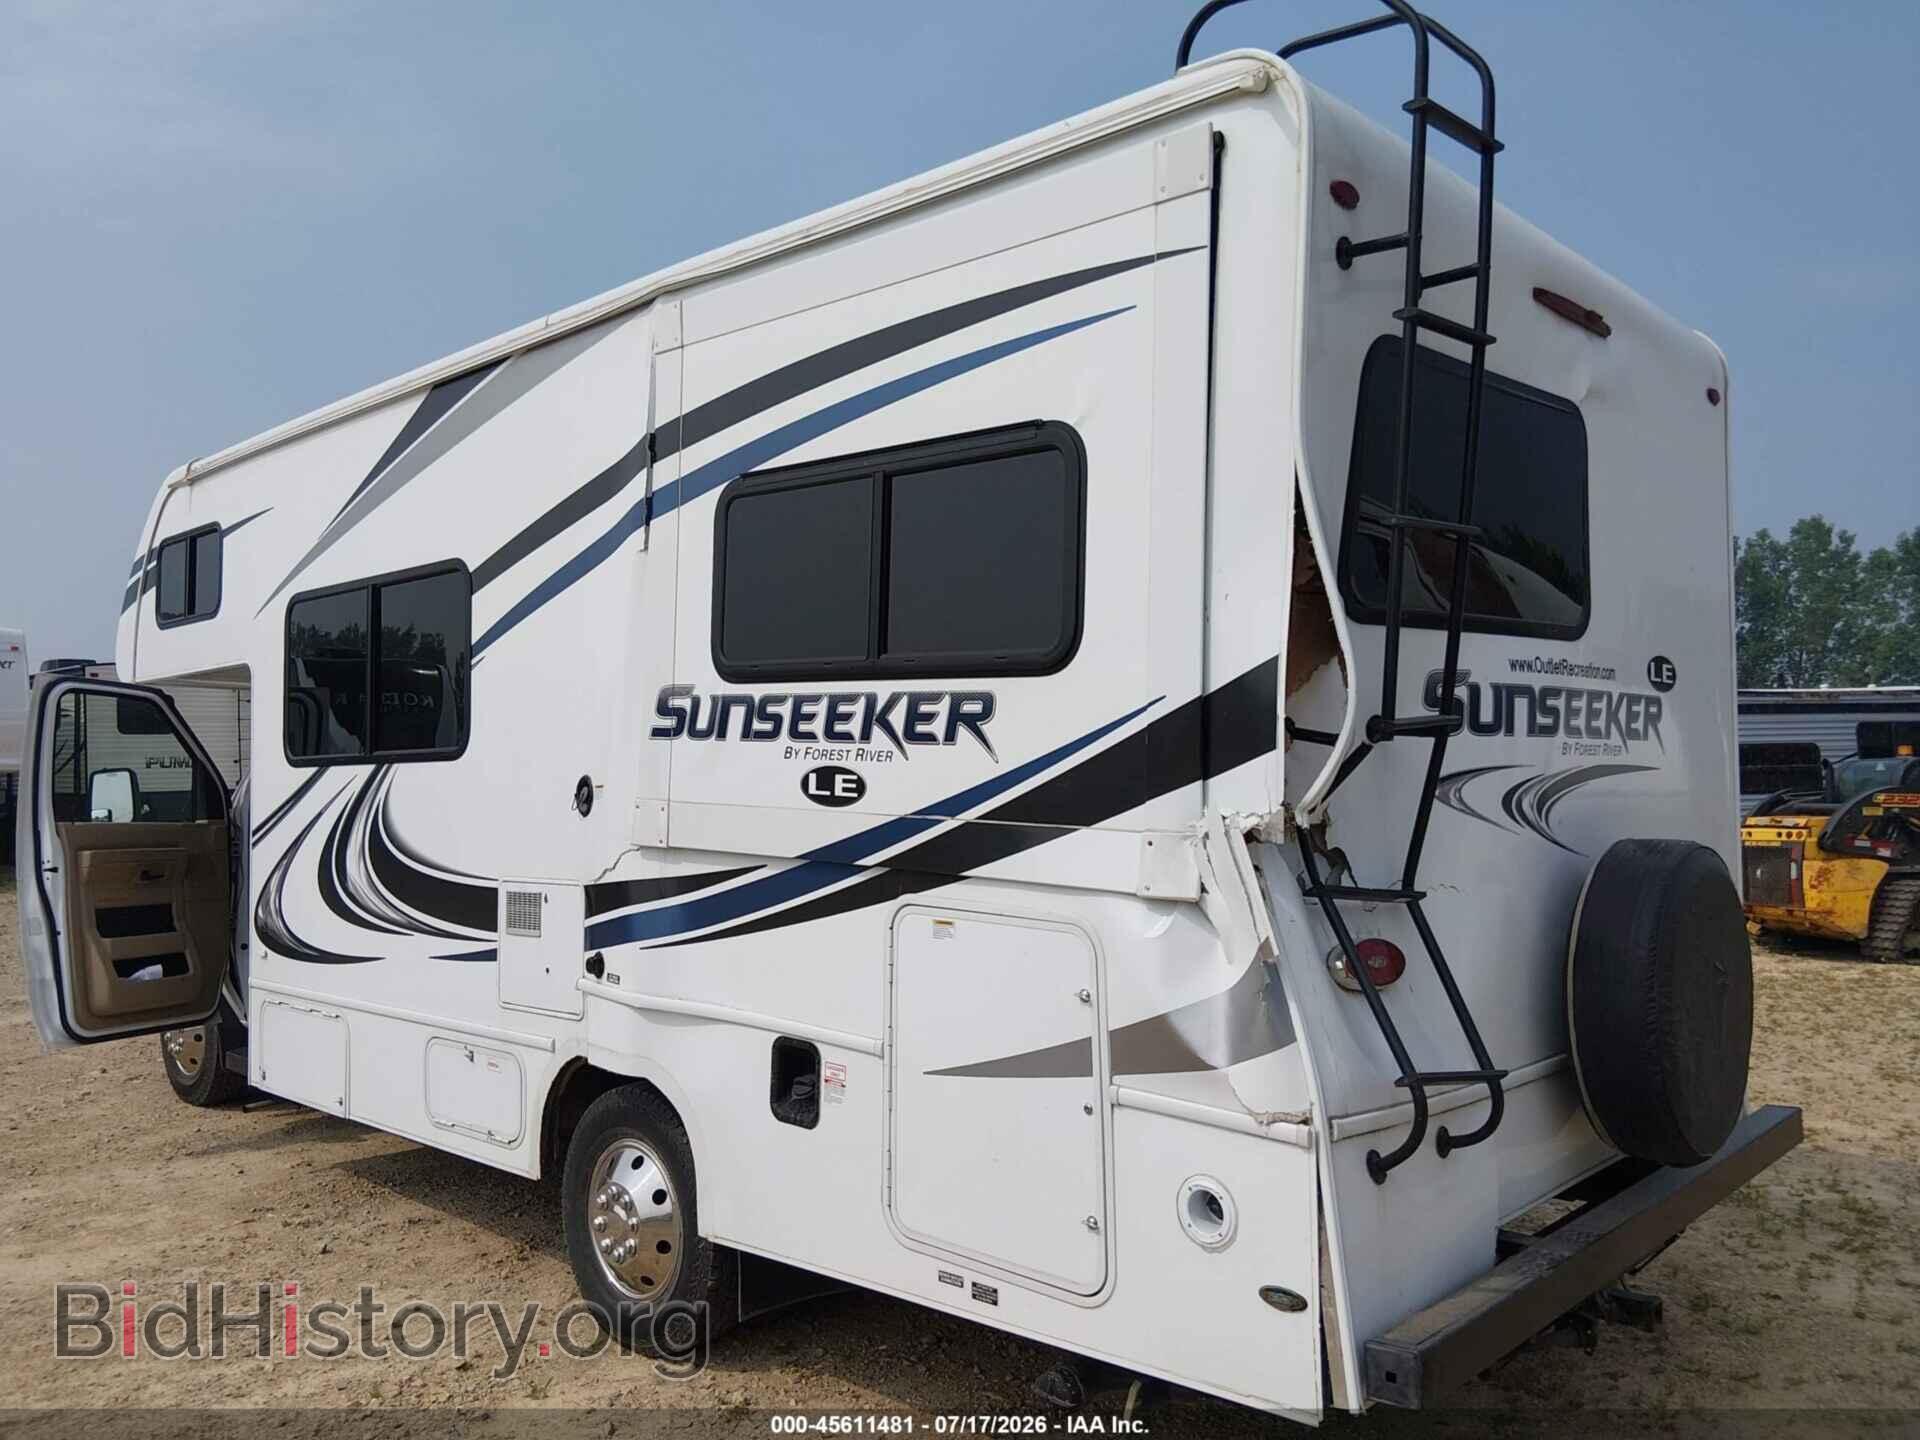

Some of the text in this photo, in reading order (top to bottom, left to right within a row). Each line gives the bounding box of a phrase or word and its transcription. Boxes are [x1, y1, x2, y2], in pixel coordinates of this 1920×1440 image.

[1508, 656, 1616, 681] www.OutletRecreation.com
[1651, 662, 1674, 684] LE
[648, 684, 999, 764] SUNSEEKER
[144, 756, 193, 769] PUM
[784, 746, 894, 762] BY FOREST RIVER
[808, 772, 858, 798] LE
